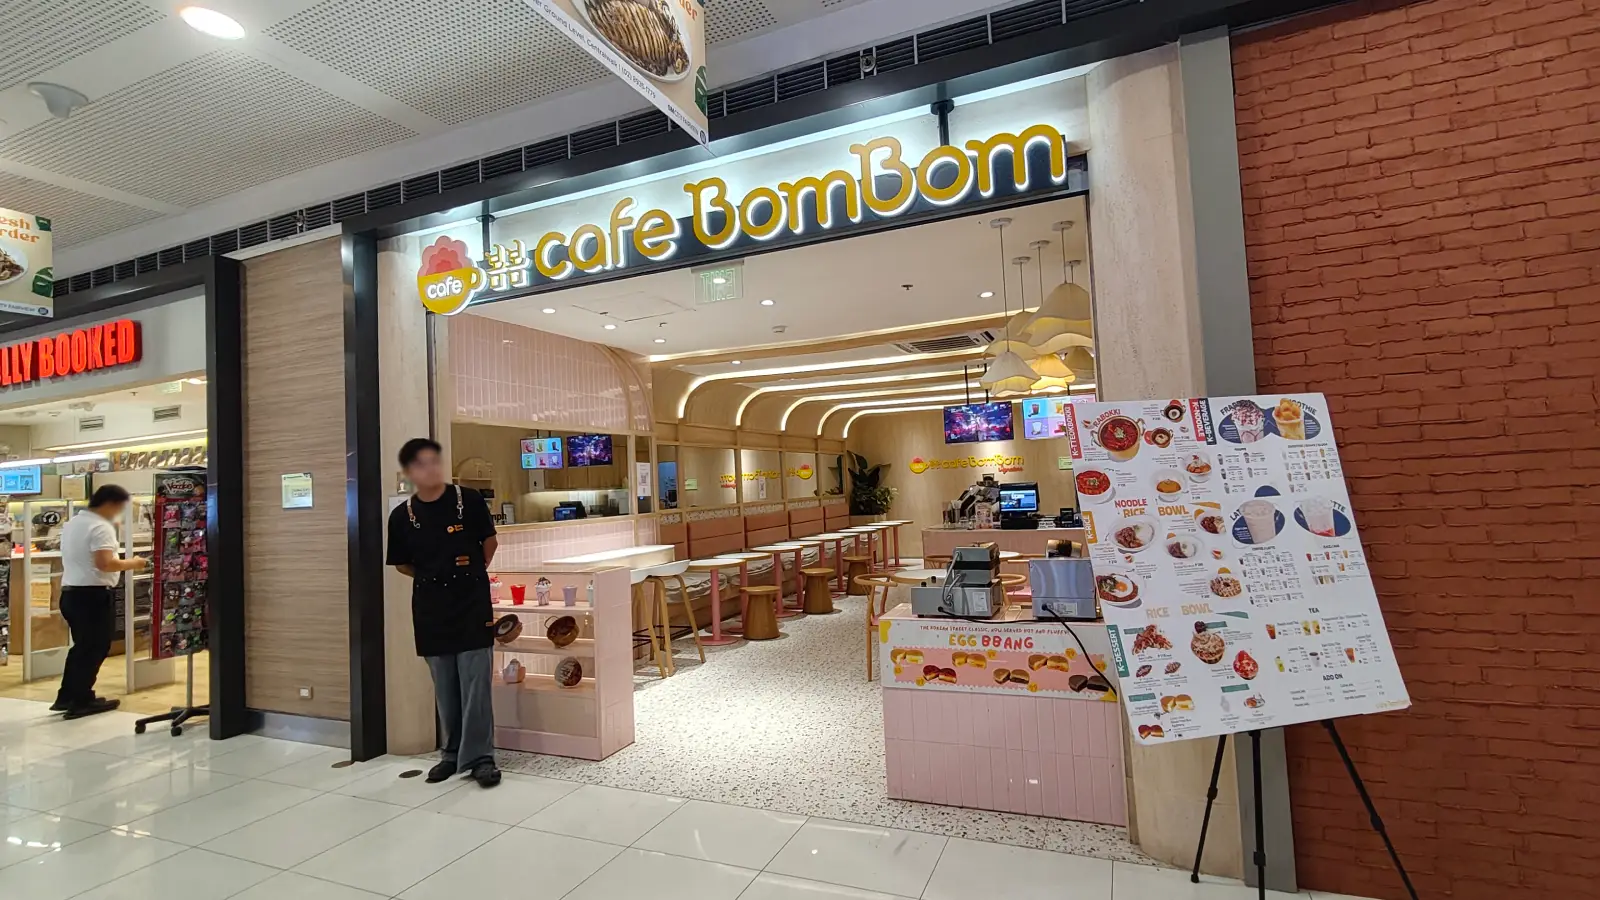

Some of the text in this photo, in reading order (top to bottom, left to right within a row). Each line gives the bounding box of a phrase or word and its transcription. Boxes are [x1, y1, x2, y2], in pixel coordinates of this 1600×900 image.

[543, 4, 568, 28] Ground
[535, 196, 679, 281] cafe
[427, 275, 464, 299] cafe
[38, 319, 136, 378] BOOKED
[1093, 409, 1121, 427] RABOKKI
[1200, 399, 1214, 442] K-BEVERAGE
[1114, 498, 1148, 508] NOODLE
[1123, 504, 1190, 519] RICE BOWL
[1146, 603, 1214, 619] RICE BOWL
[949, 633, 977, 647] EGG
[1108, 628, 1126, 672] K-DESSERT
